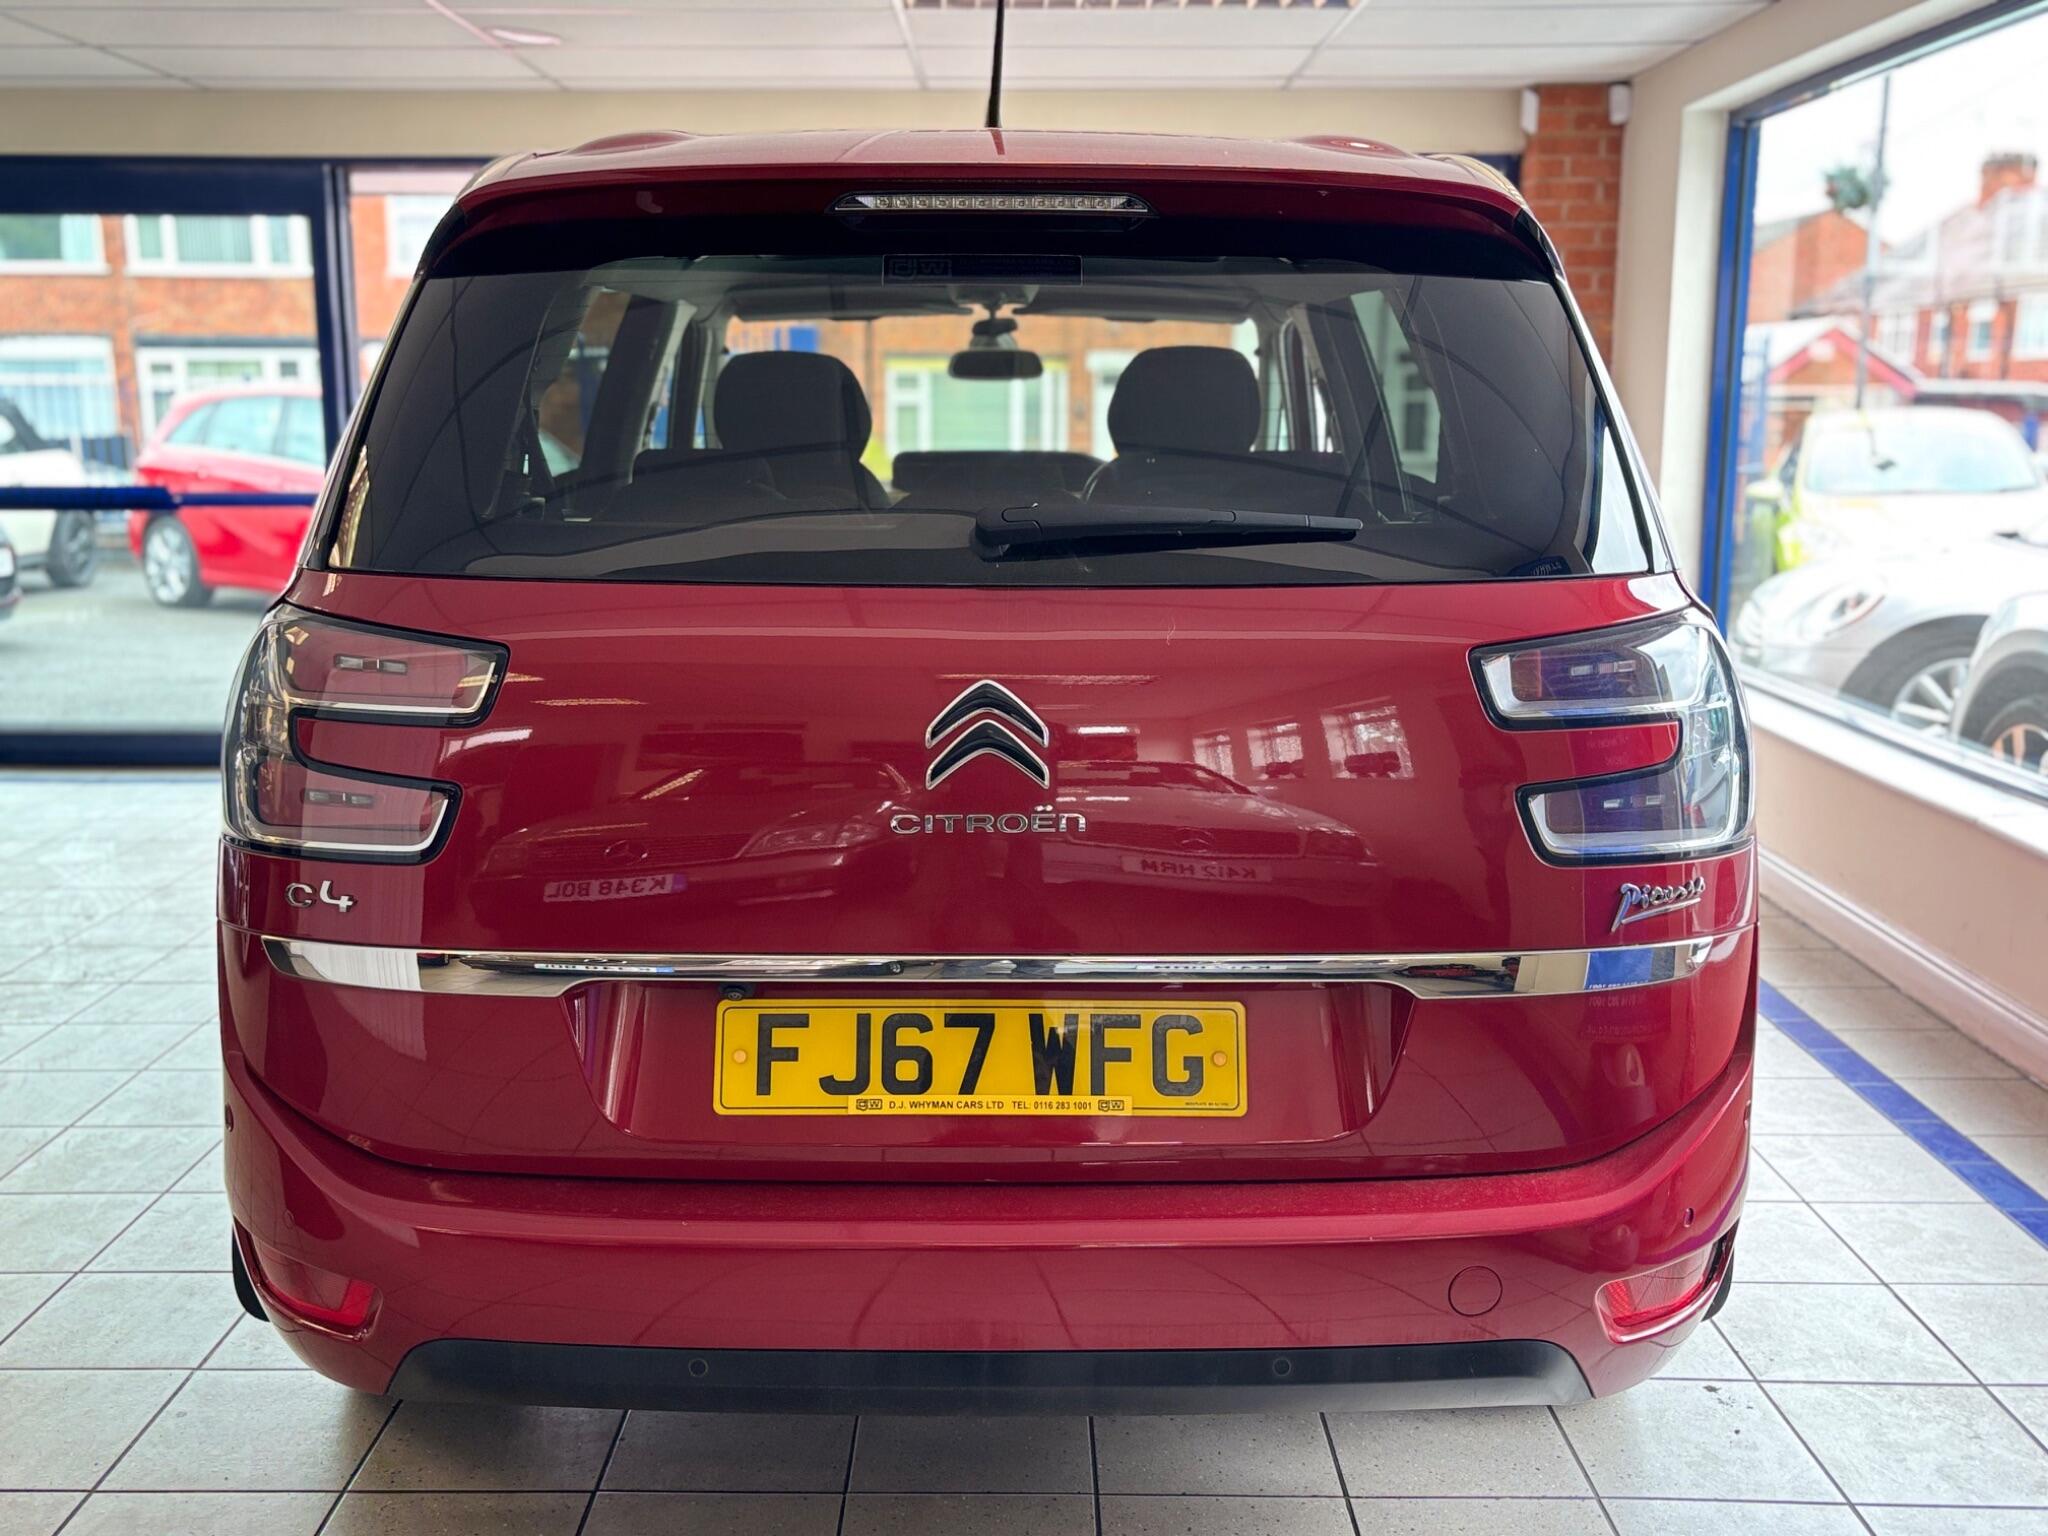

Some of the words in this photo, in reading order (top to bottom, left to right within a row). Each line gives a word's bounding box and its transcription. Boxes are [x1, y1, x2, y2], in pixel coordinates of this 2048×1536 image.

[284, 879, 358, 913] C4
[756, 1013, 996, 1097] FJ67
[1028, 1013, 1204, 1097] WFG
[909, 1100, 954, 1110] WHYMAN
[956, 1100, 983, 1110] CARS
[986, 1100, 1004, 1110] LTD
[1033, 1100, 1052, 1110] 0116
[1055, 1100, 1071, 1110] 283
[1073, 1101, 1092, 1111] 1001
